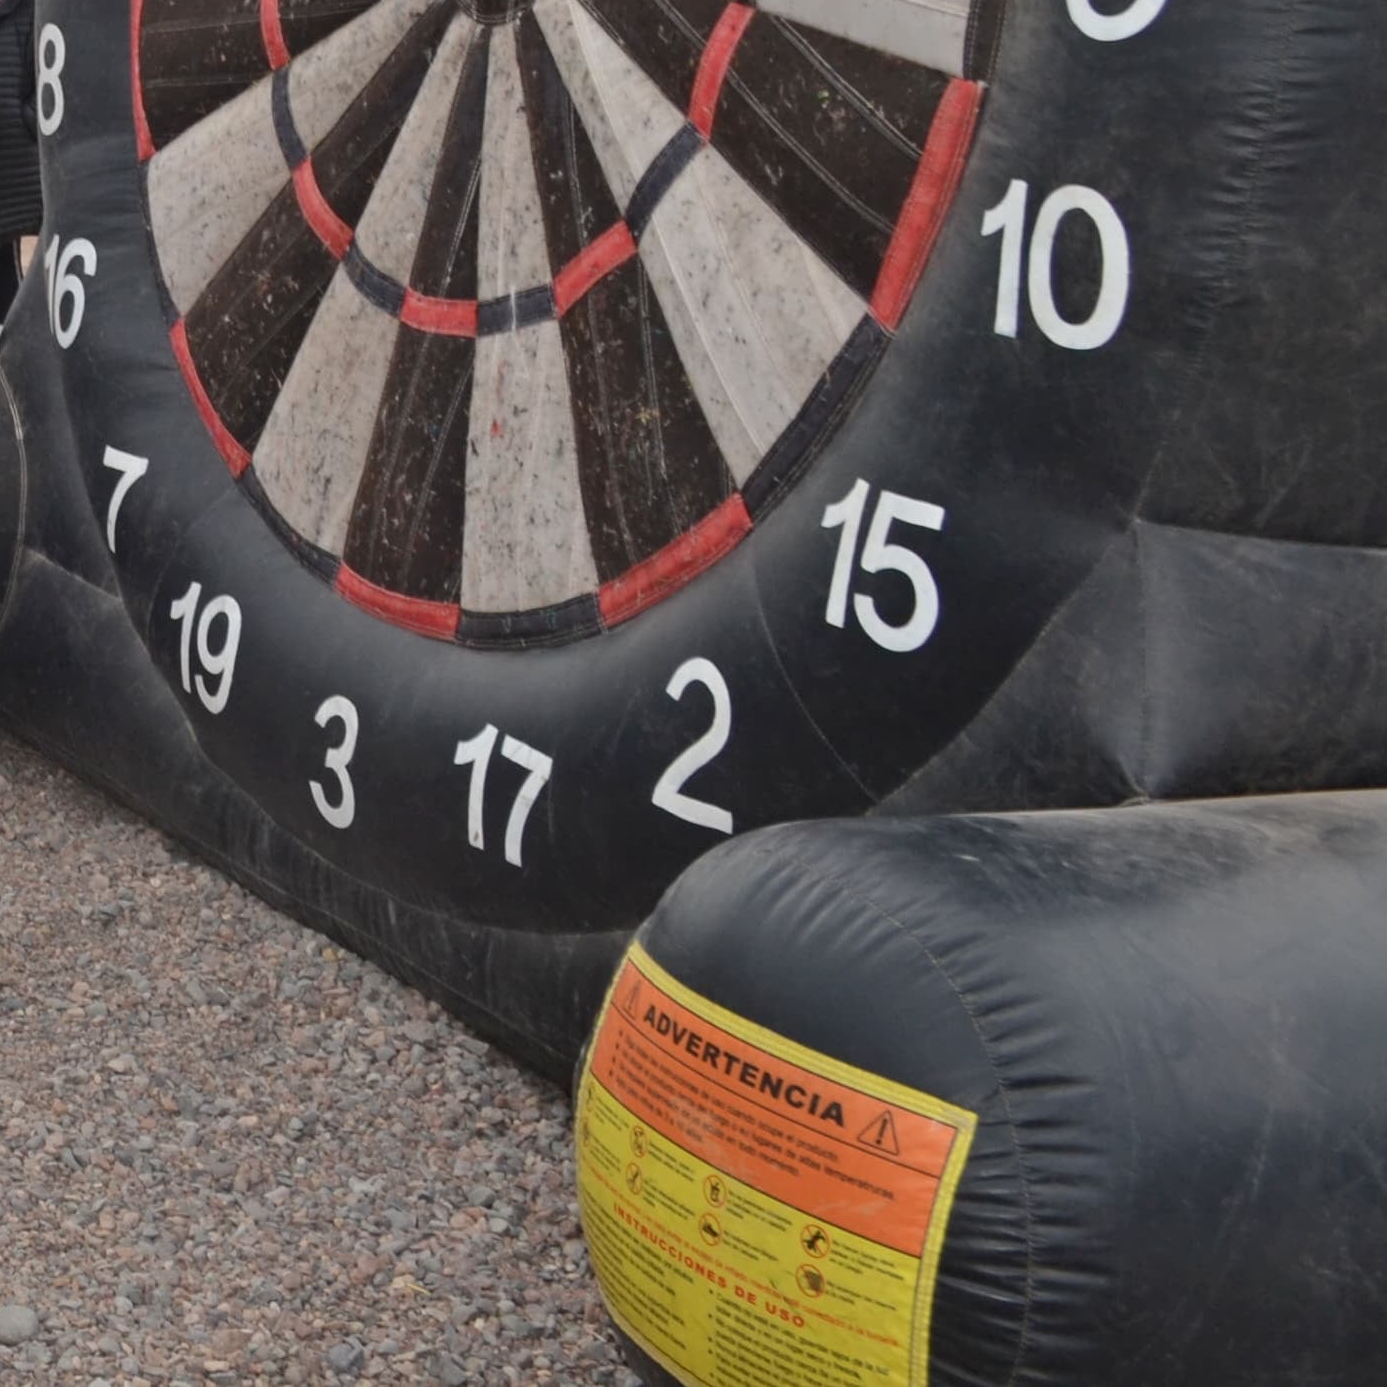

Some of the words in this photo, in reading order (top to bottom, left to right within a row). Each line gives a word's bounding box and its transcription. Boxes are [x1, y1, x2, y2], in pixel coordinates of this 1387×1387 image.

[37, 22, 66, 136] 8
[44, 234, 97, 349] 16
[981, 179, 1130, 350] 10
[103, 445, 149, 553] 7
[821, 478, 945, 652] 15
[171, 582, 242, 714] 19
[309, 695, 359, 829] 3
[454, 724, 554, 867] 17
[652, 657, 733, 834] 2
[643, 1004, 845, 1127] ADVERTENCIA
[613, 1202, 727, 1289] INSTRUCCIONES
[734, 1285, 757, 1306] DE
[765, 1301, 806, 1328] USO
